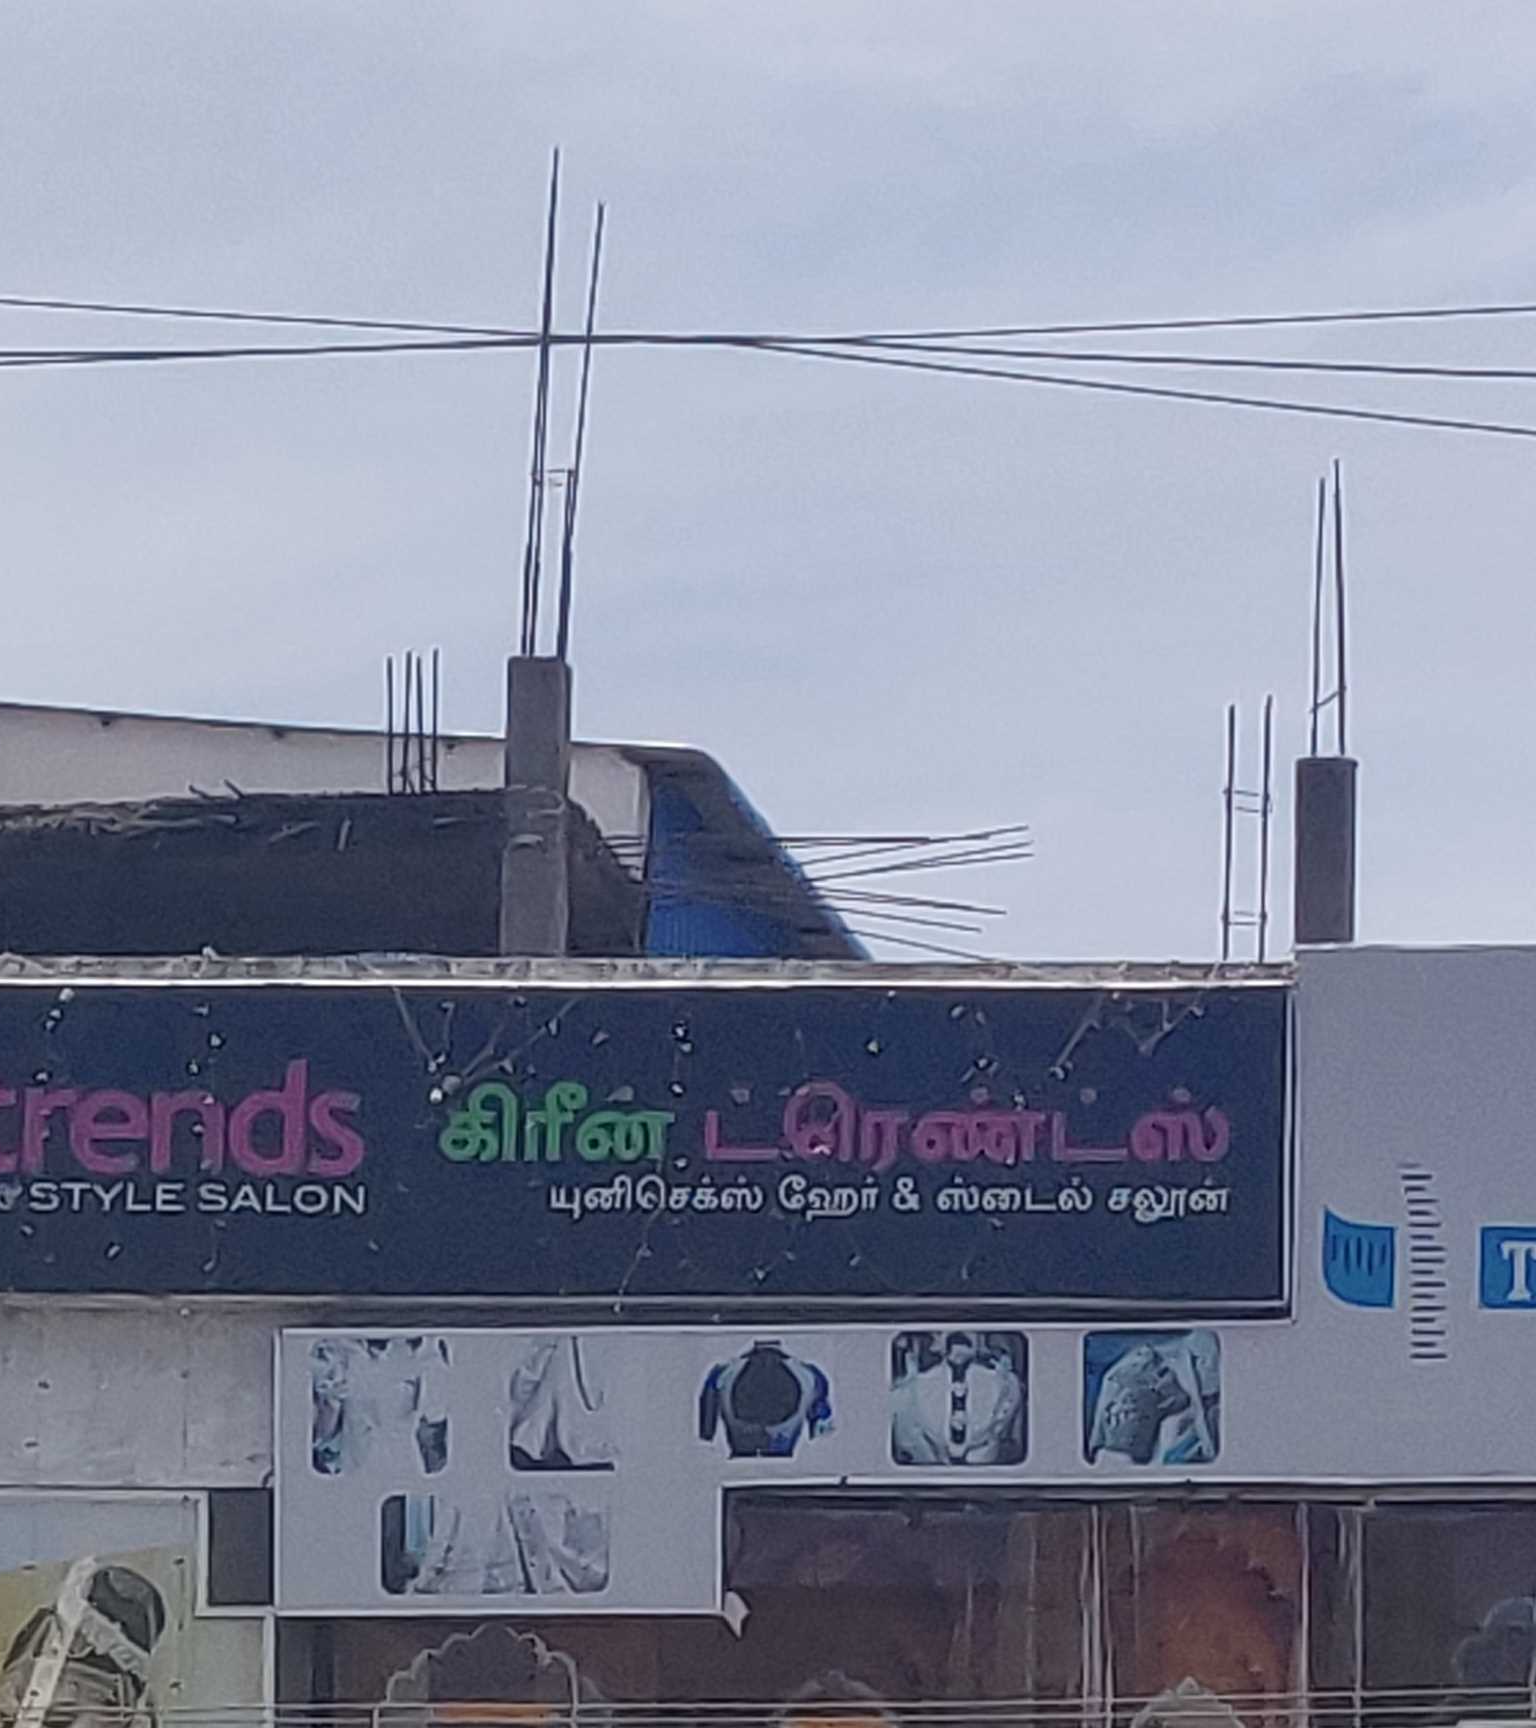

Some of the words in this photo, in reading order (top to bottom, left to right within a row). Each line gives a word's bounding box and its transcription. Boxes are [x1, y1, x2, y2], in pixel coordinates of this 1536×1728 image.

[29, 1181, 187, 1214] STYLE
[196, 1182, 367, 1216] SALON
[892, 1178, 921, 1213] &
